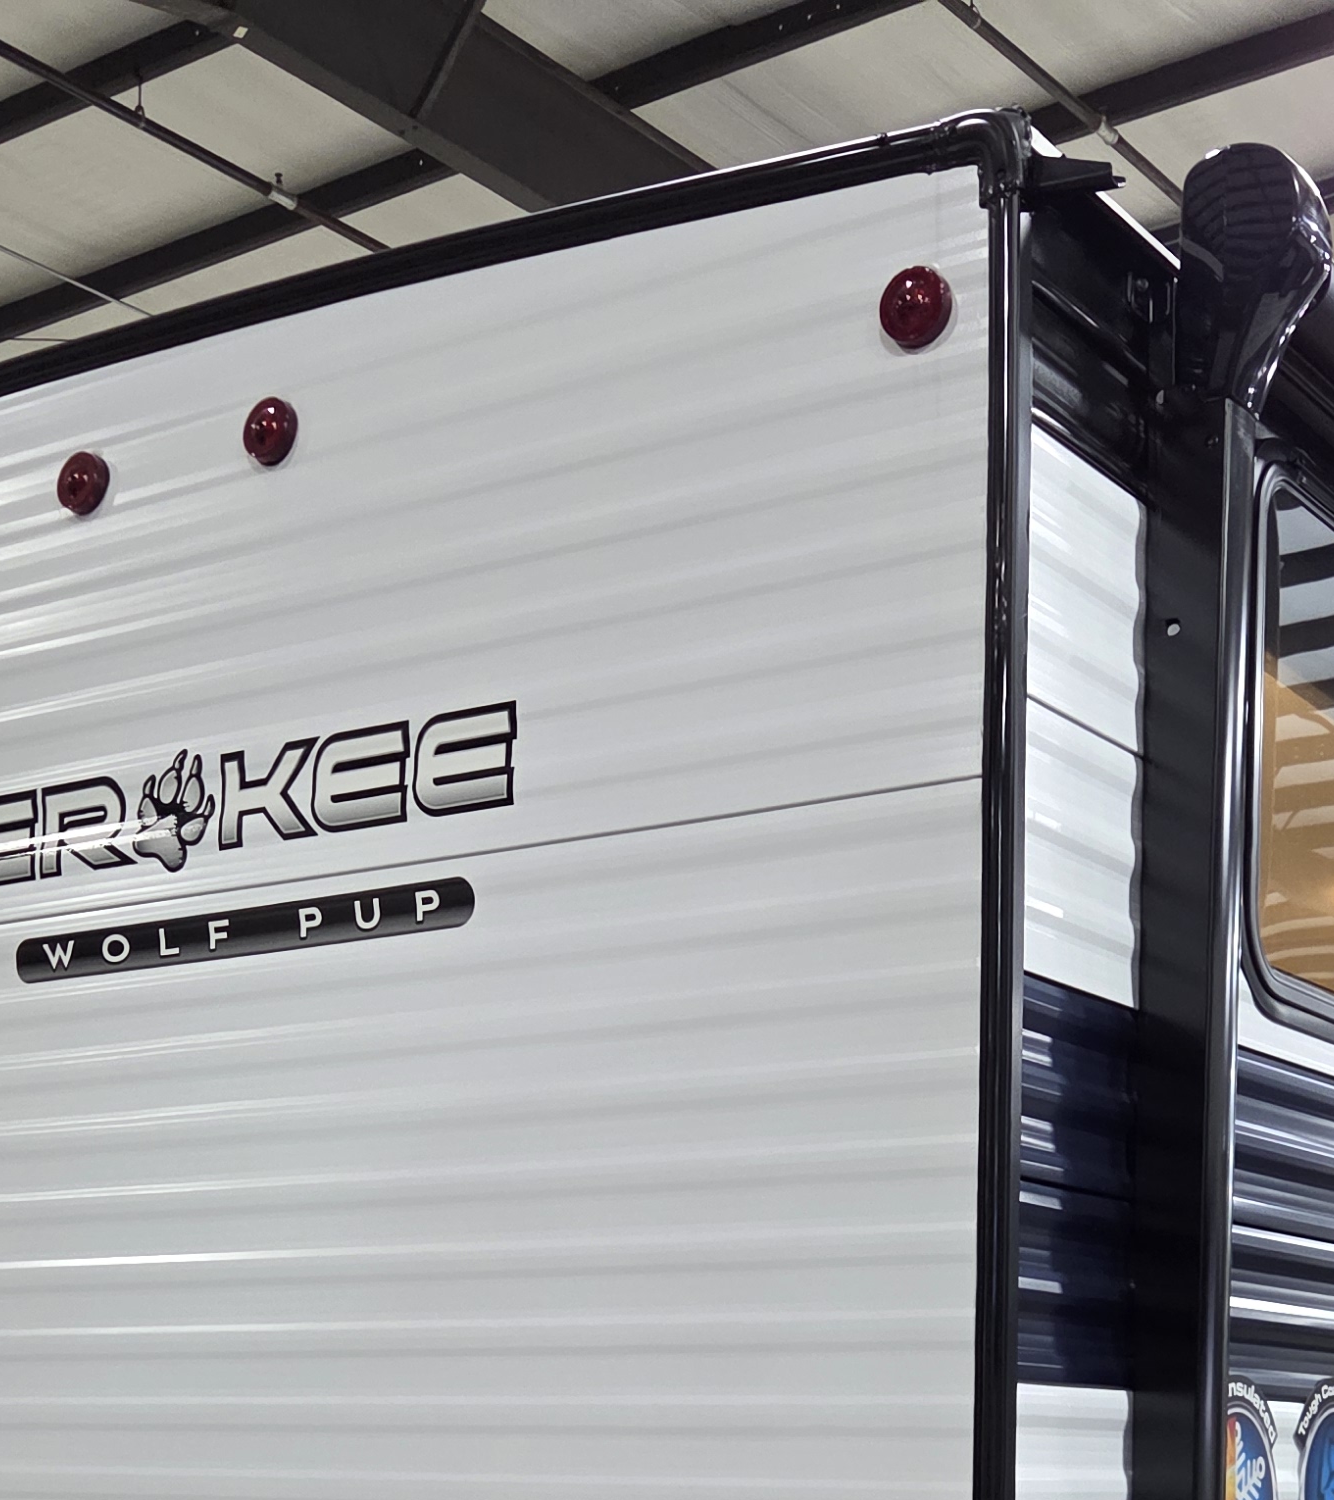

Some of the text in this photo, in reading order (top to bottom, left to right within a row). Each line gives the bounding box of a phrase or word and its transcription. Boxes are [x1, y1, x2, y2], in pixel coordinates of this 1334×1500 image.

[42, 889, 441, 970] WOLF PUP
[1227, 1381, 1277, 1444] nsulated
[1297, 1393, 1323, 1436] Tough
